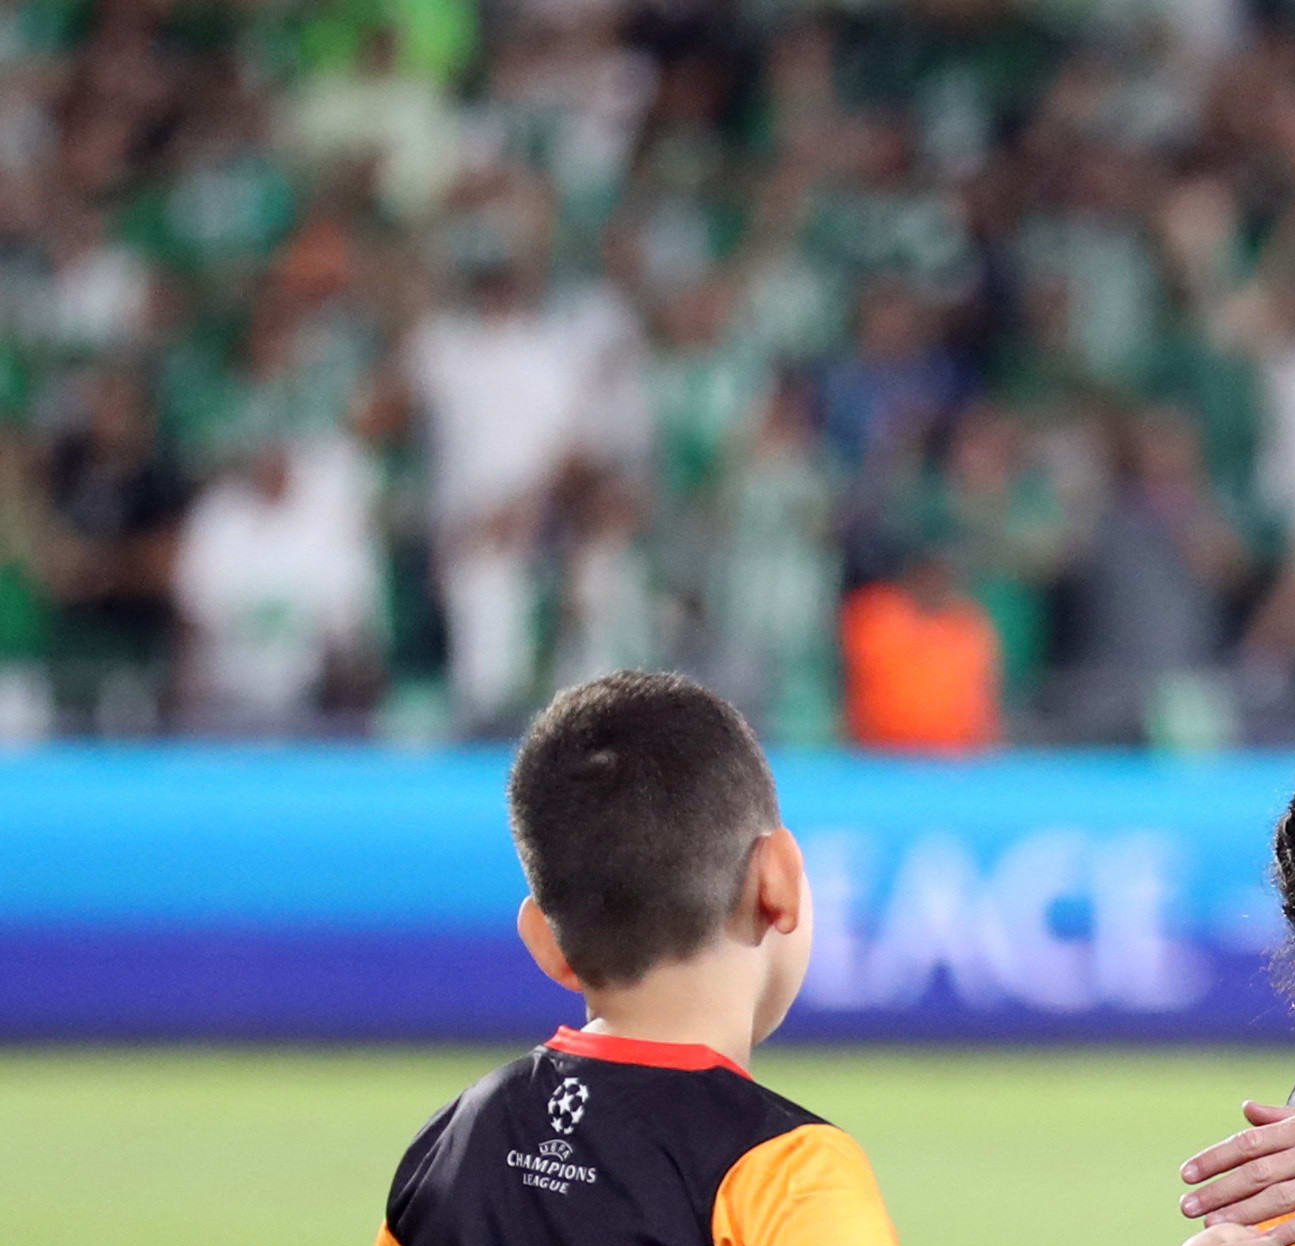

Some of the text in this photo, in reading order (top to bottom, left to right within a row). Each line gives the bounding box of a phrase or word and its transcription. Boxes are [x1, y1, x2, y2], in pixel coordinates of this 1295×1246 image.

[808, 826, 1214, 1012] EACE
[539, 1141, 572, 1160] UEFA
[507, 1150, 597, 1184] CHAMPIONS
[523, 1173, 570, 1195] LEAGUE
